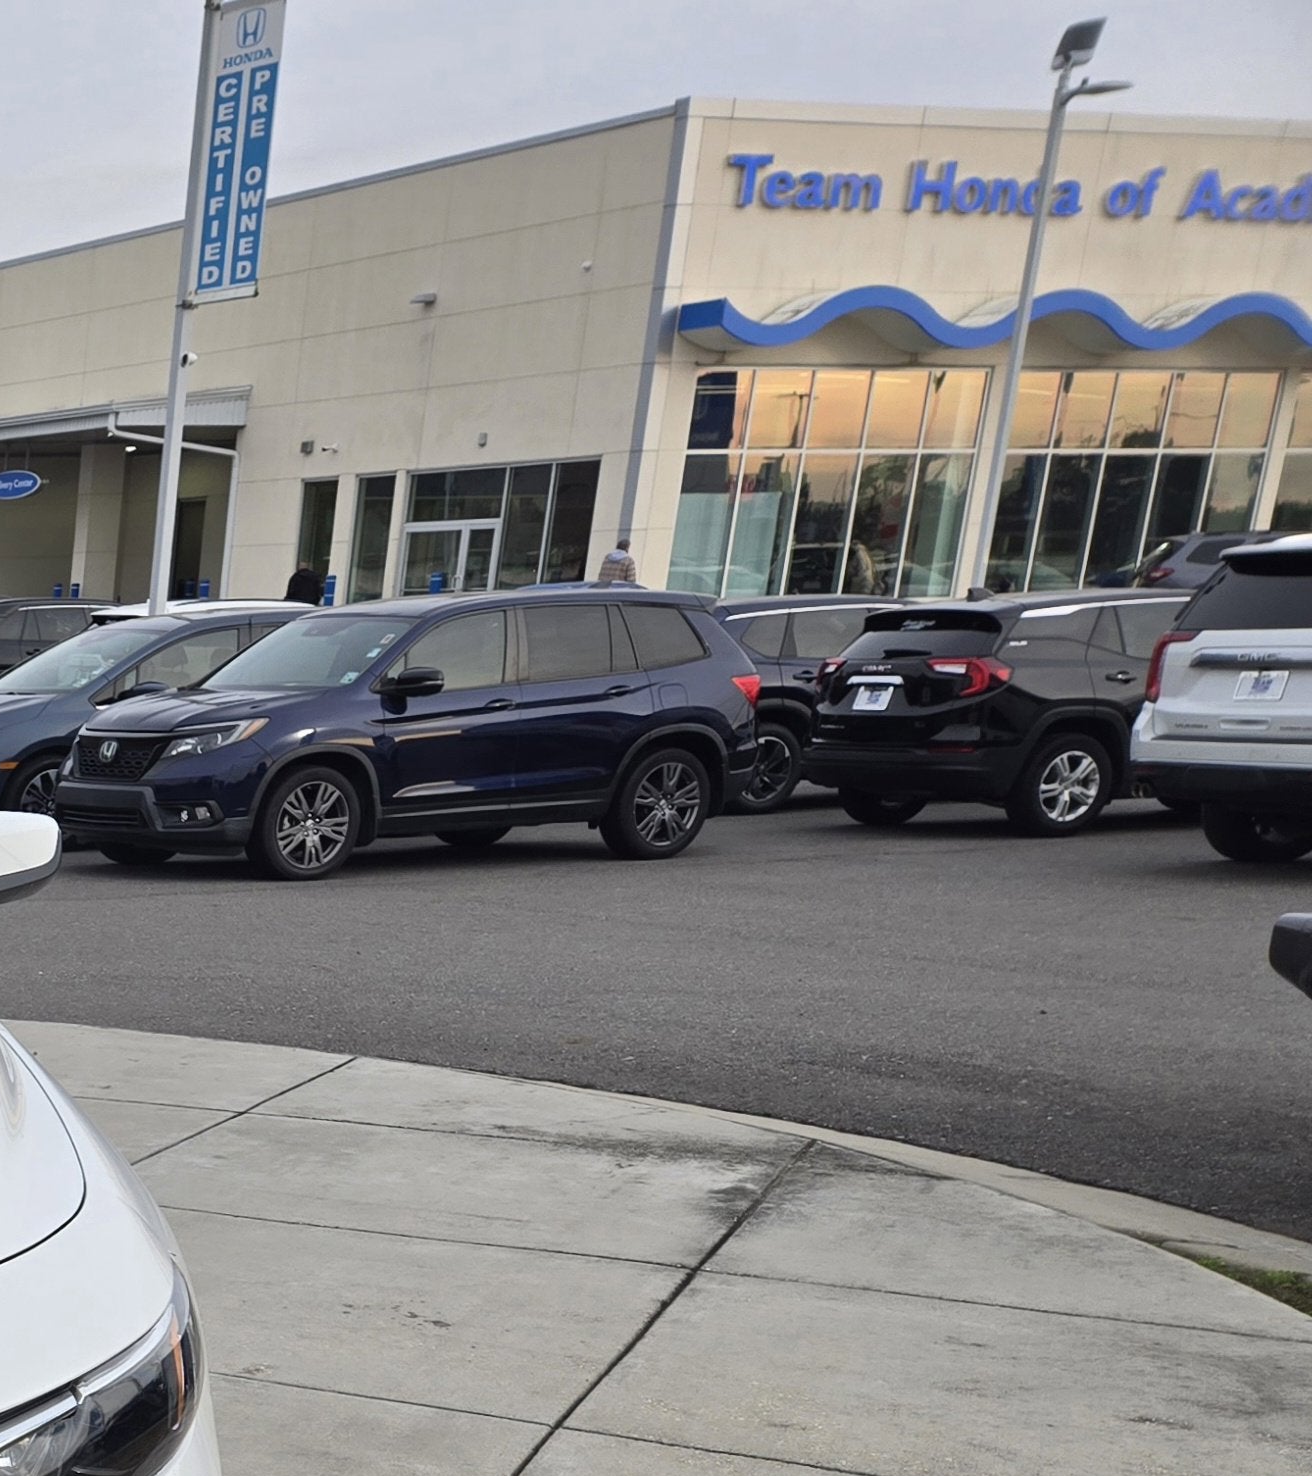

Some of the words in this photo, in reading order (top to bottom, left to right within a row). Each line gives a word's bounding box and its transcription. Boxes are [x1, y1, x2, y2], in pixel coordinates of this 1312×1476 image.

[223, 47, 273, 69] HONDA
[250, 69, 271, 139] PRE
[201, 78, 238, 285] CERTIFIED
[728, 153, 883, 211] Team
[1106, 166, 1168, 217] of
[1181, 168, 1312, 221] Acad
[236, 166, 264, 280] OWNED
